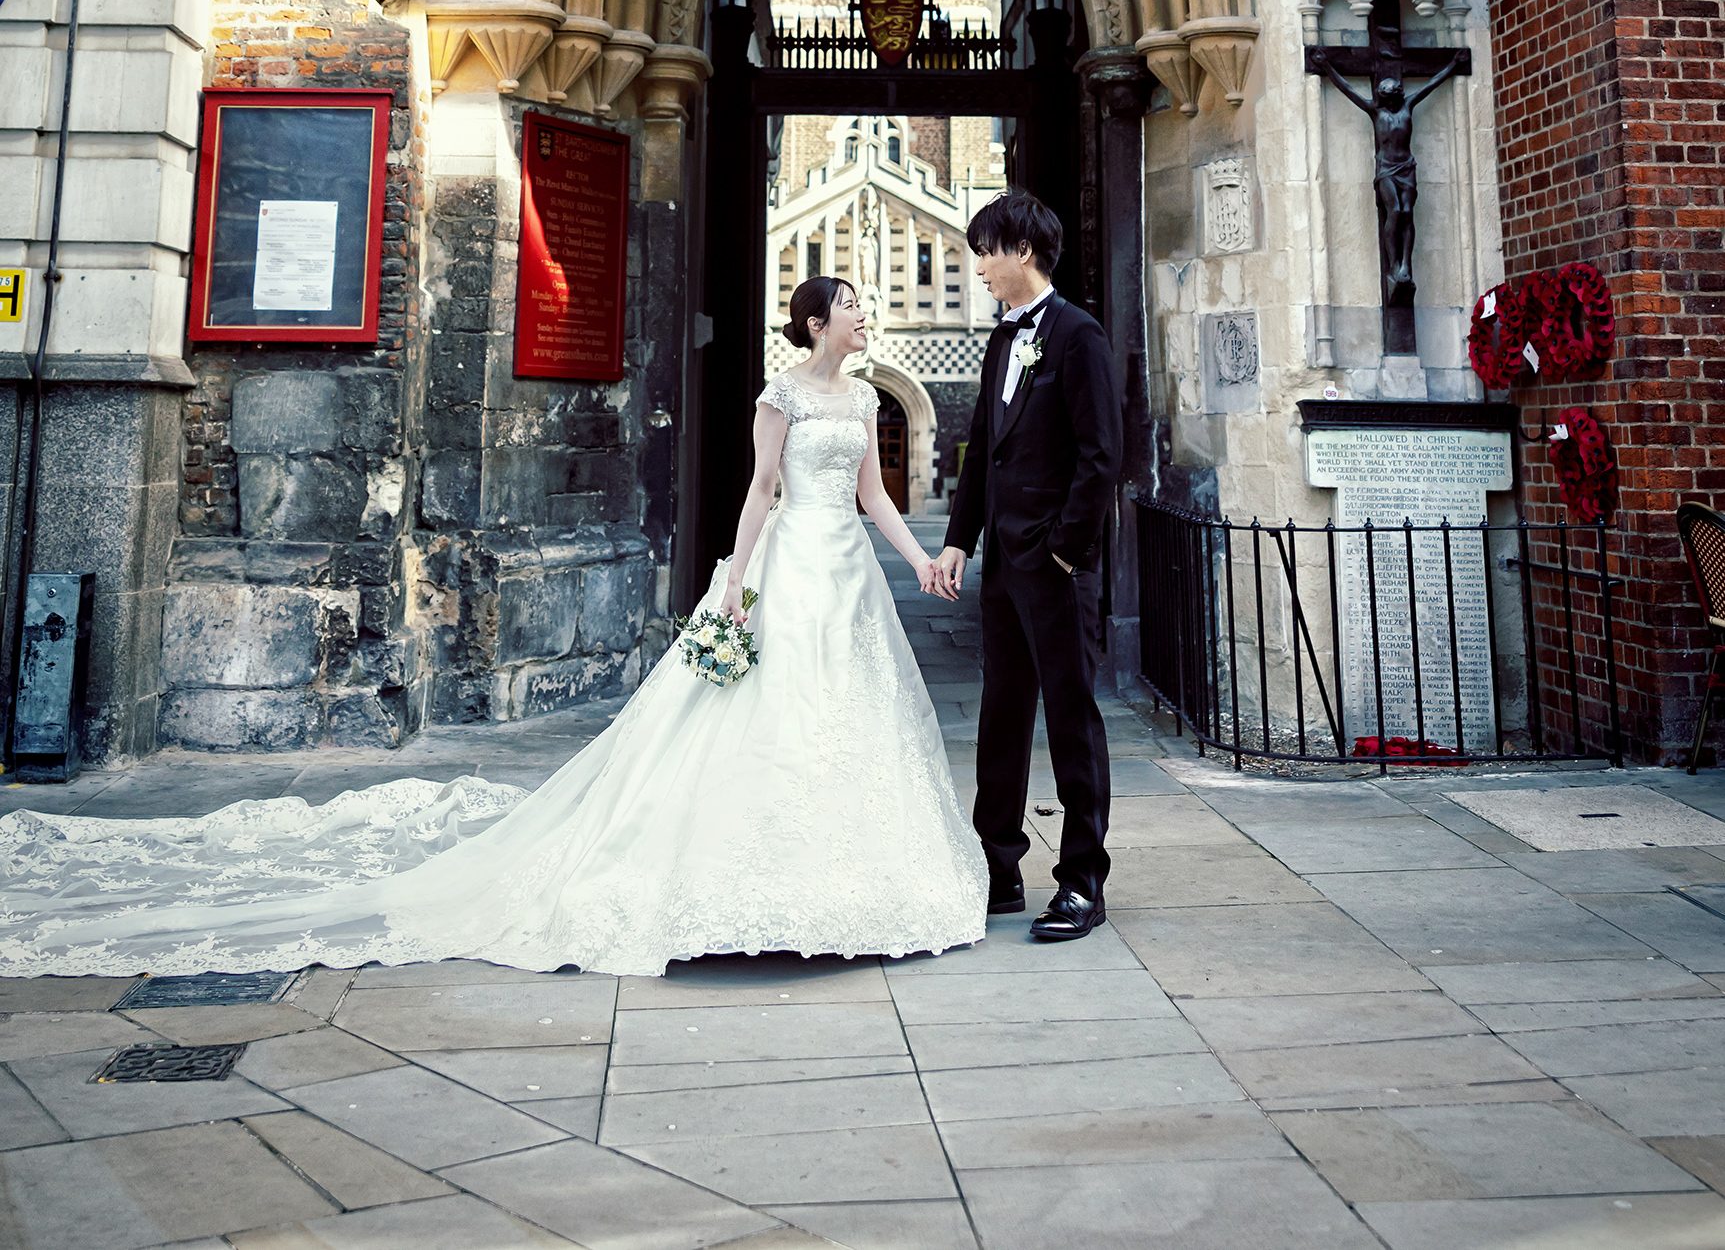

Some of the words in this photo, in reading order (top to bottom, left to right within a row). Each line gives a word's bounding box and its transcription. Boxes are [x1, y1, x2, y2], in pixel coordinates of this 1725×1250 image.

[550, 197, 575, 209] SUNDAY
[576, 202, 605, 215] SERVICES
[531, 290, 553, 303] Monday
[1356, 434, 1408, 443] HALLOWED
[1427, 436, 1462, 444] CHRIST
